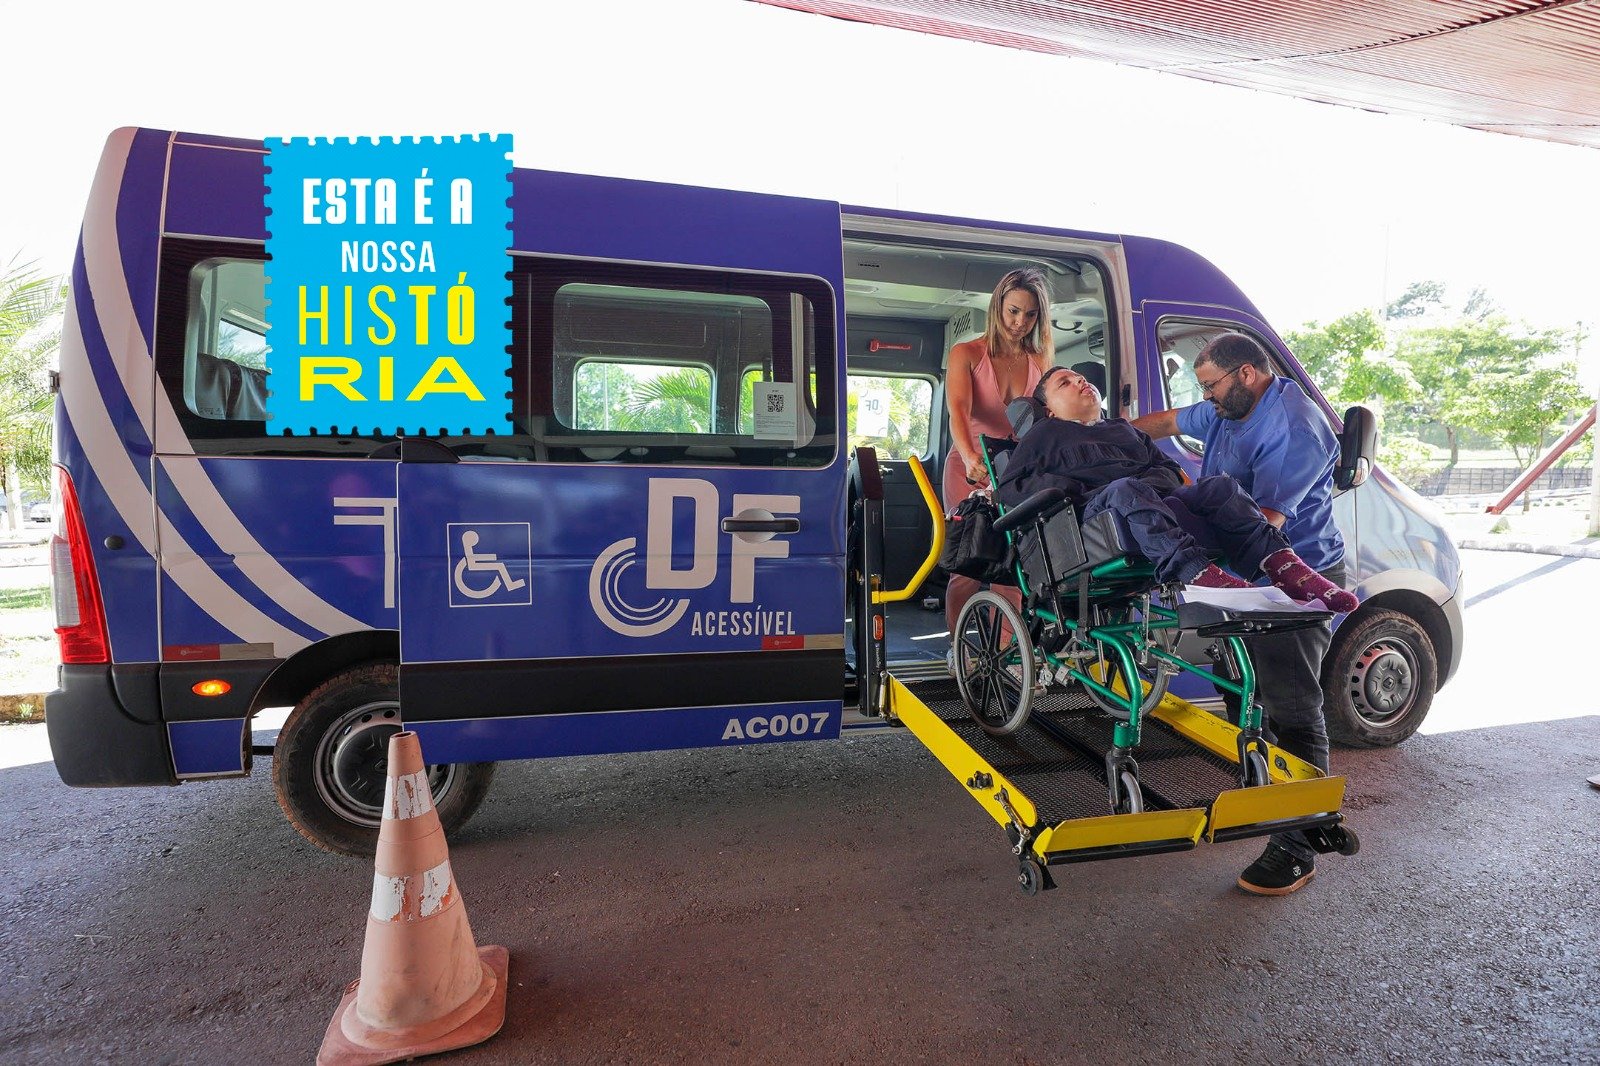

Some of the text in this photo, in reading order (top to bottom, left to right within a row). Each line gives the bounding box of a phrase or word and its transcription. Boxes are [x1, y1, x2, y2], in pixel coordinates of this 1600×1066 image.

[645, 477, 802, 604] DF
[690, 605, 797, 637] ACESSÍVEL
[721, 712, 830, 741] AC007
